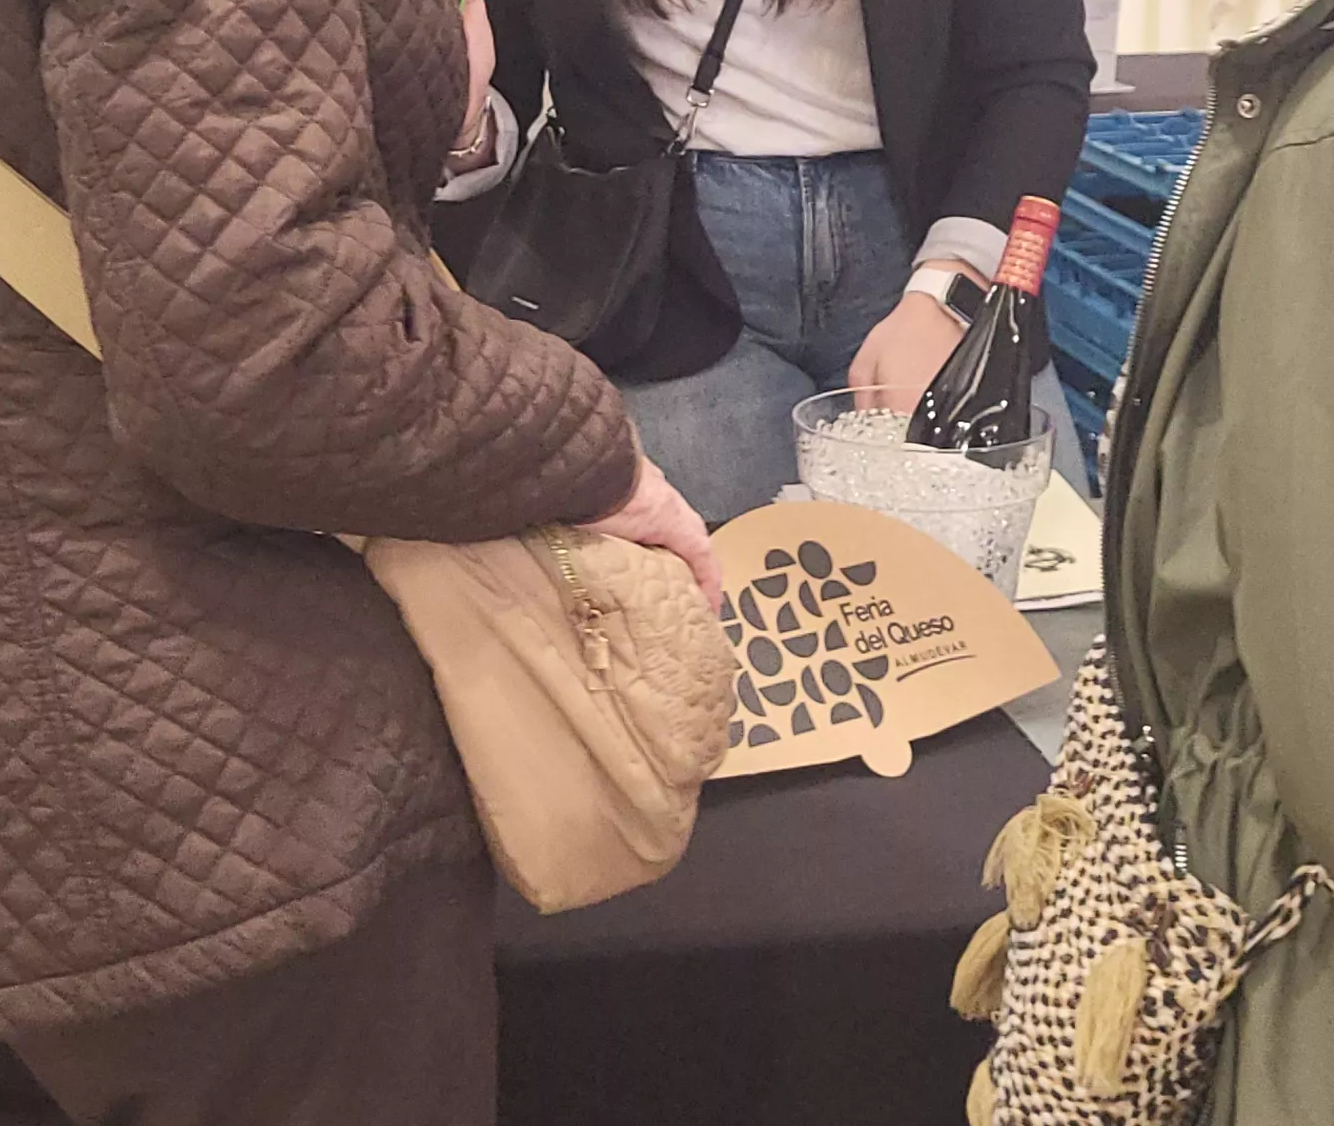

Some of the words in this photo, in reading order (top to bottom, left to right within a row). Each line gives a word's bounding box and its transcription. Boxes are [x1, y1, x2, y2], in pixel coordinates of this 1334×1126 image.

[839, 595, 895, 626] Feria
[855, 626, 888, 654] del
[887, 614, 954, 645] Queso
